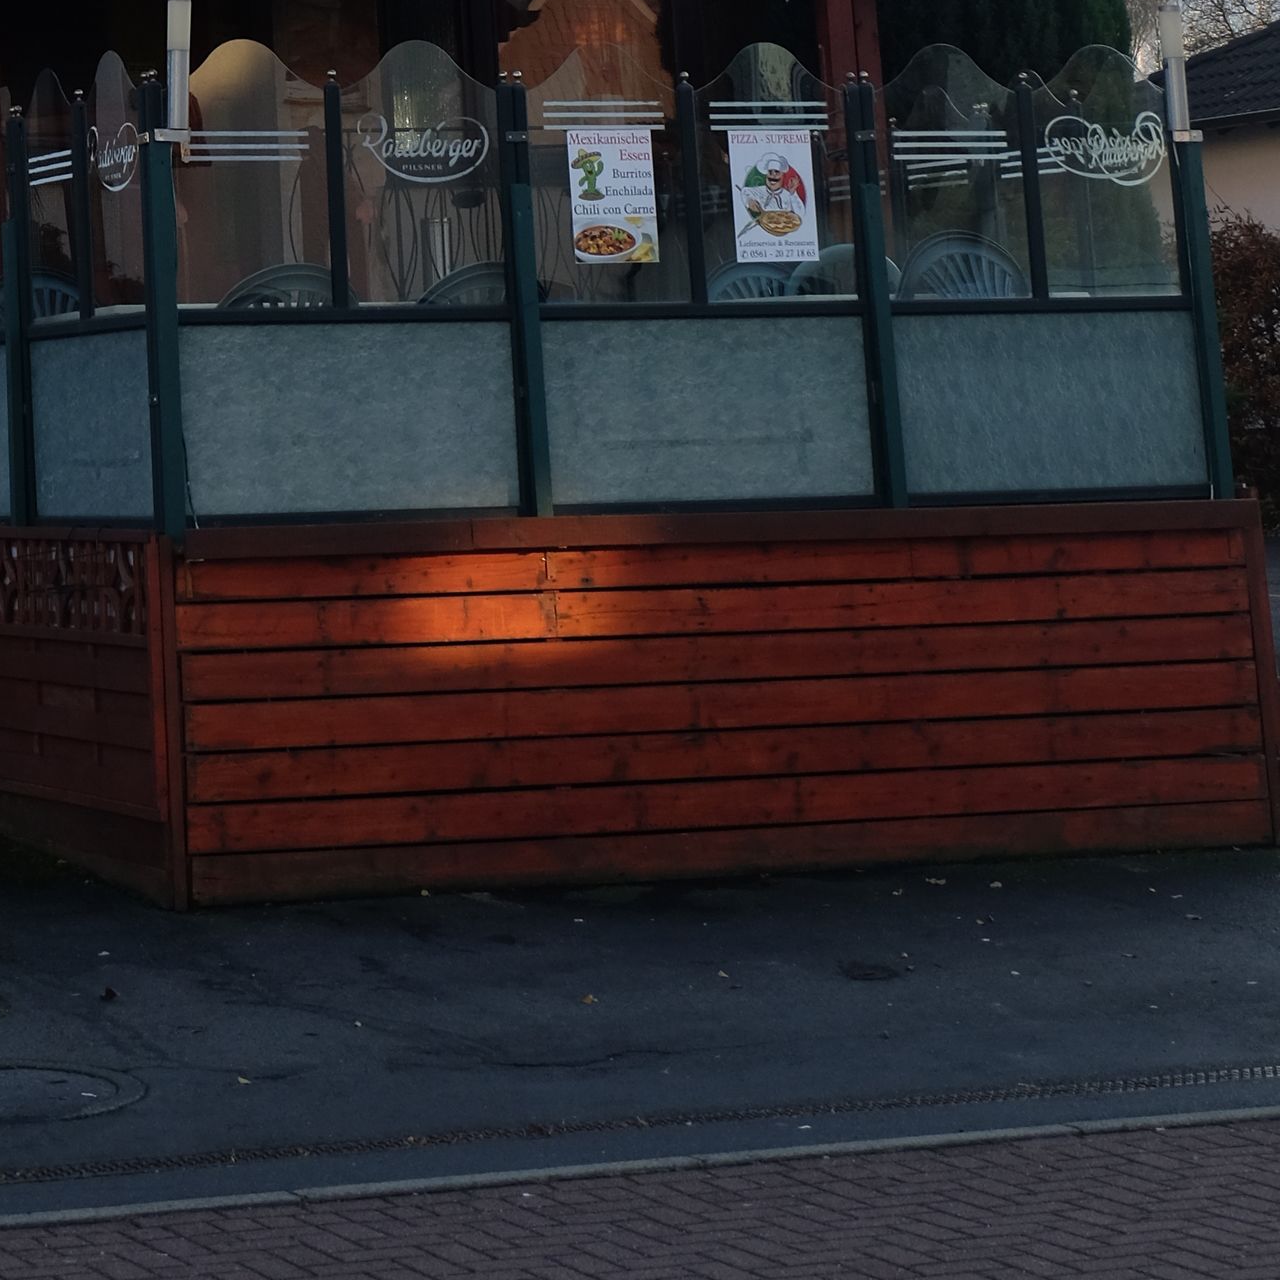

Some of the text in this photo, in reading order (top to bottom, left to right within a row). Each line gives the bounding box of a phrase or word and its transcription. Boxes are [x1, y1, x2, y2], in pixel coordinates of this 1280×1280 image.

[568, 132, 650, 145] Mexikanisches
[730, 134, 758, 144] PIZZA
[765, 134, 809, 144] SUPREME
[619, 149, 651, 161] Essen
[402, 163, 443, 171] PILSNER
[612, 168, 652, 179] Burritos
[605, 186, 653, 197] Enchilada
[574, 203, 655, 216] Chili con Carne
